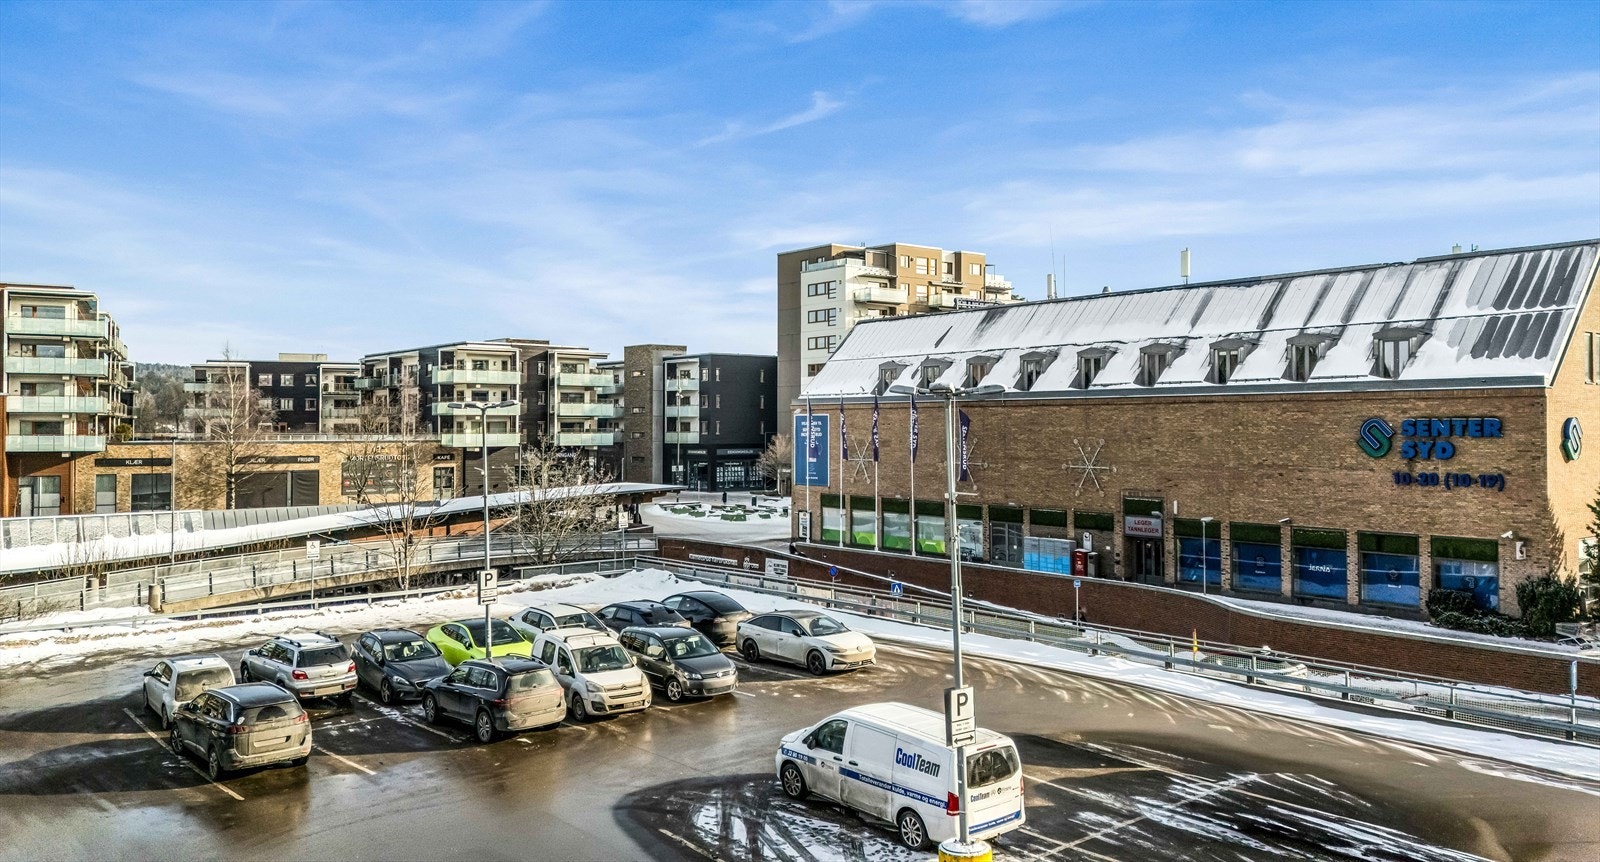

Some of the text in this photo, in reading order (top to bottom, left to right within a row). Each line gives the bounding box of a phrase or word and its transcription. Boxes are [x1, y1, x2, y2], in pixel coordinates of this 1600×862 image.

[1401, 417, 1503, 438] SENTER
[1400, 440, 1455, 460] SYD
[1127, 526, 1160, 534] TANNLEGER
[485, 573, 493, 587] P
[957, 692, 968, 716] P
[896, 747, 941, 778] CoolTeam
[907, 791, 921, 800] varme
